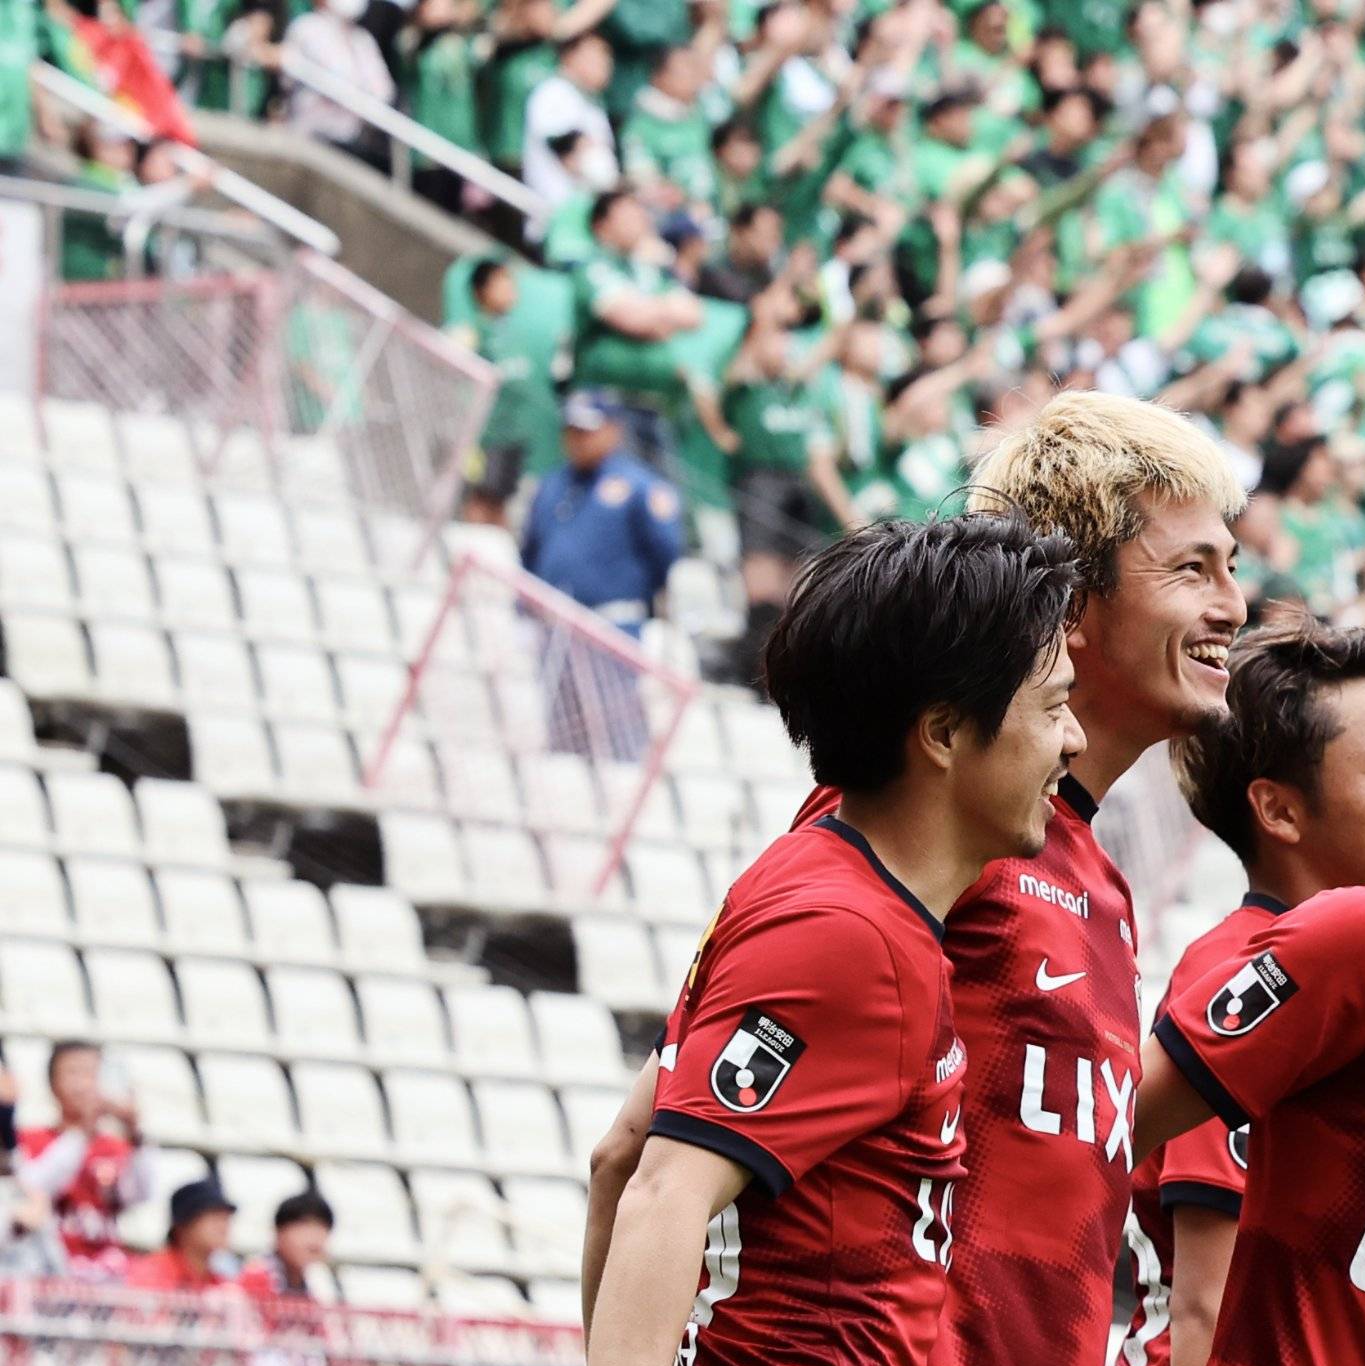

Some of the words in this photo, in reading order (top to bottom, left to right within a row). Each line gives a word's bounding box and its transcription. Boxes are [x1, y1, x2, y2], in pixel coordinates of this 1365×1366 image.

[1019, 873, 1089, 919] mercari
[1020, 1043, 1137, 1175] LIX
[912, 1178, 957, 1275] LI
